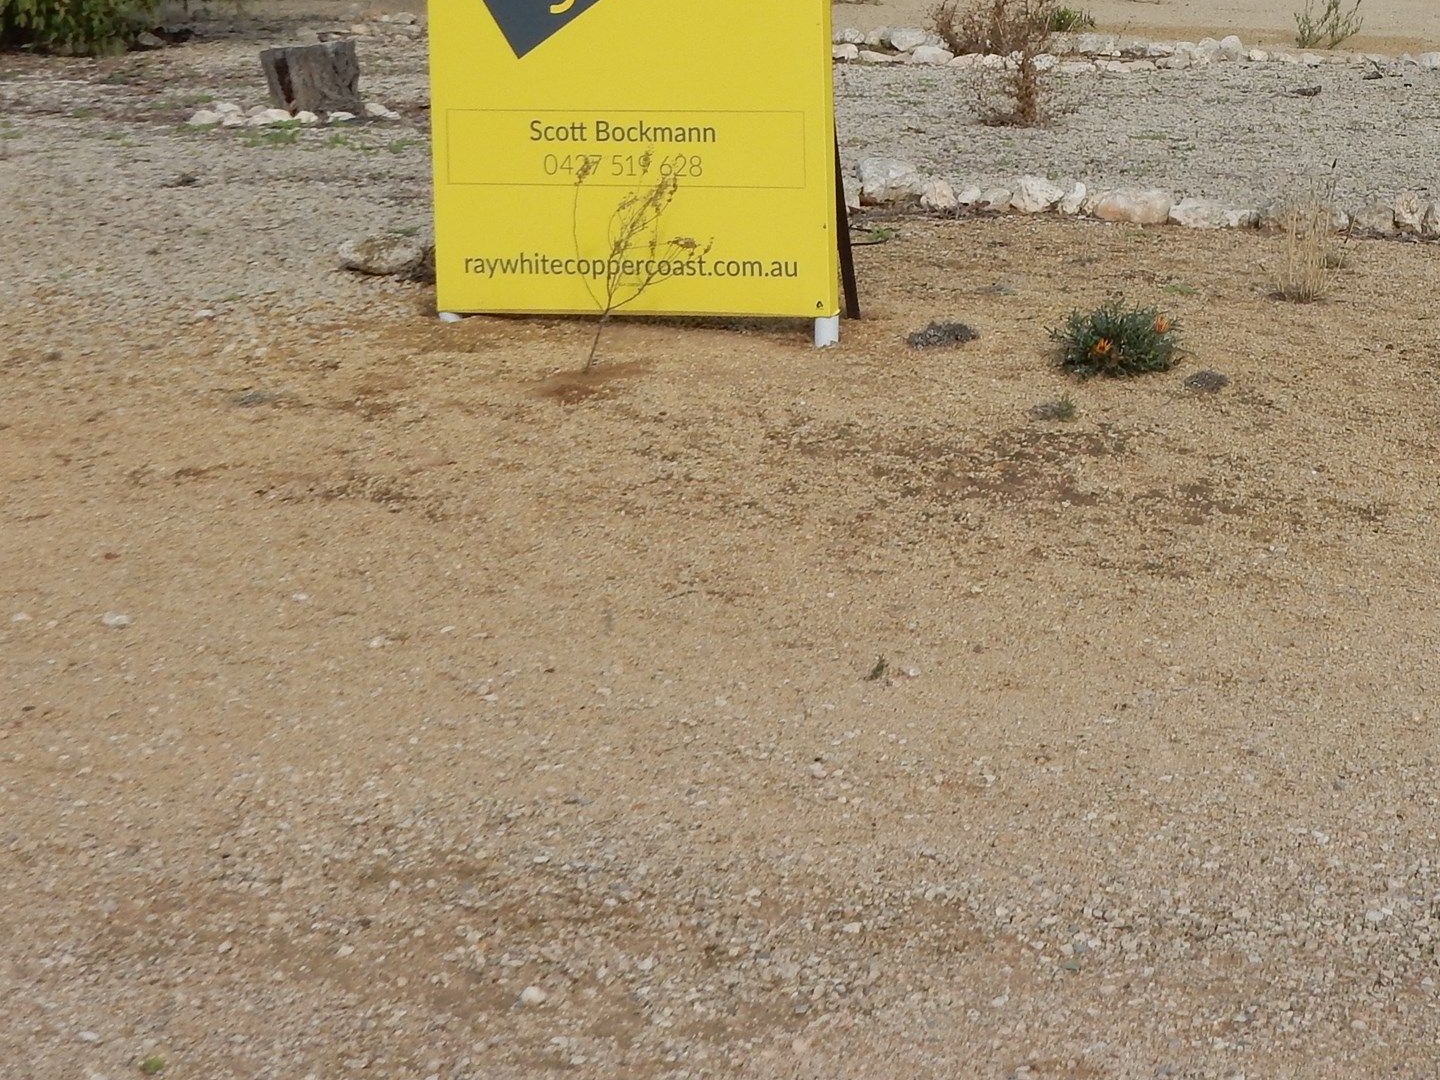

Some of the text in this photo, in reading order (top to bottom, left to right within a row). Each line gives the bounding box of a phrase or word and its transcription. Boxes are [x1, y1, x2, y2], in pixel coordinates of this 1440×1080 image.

[530, 120, 716, 143] Scott Bockmann
[659, 155, 703, 178] 628
[464, 252, 798, 280] raywhitecoppercoast.com.au
